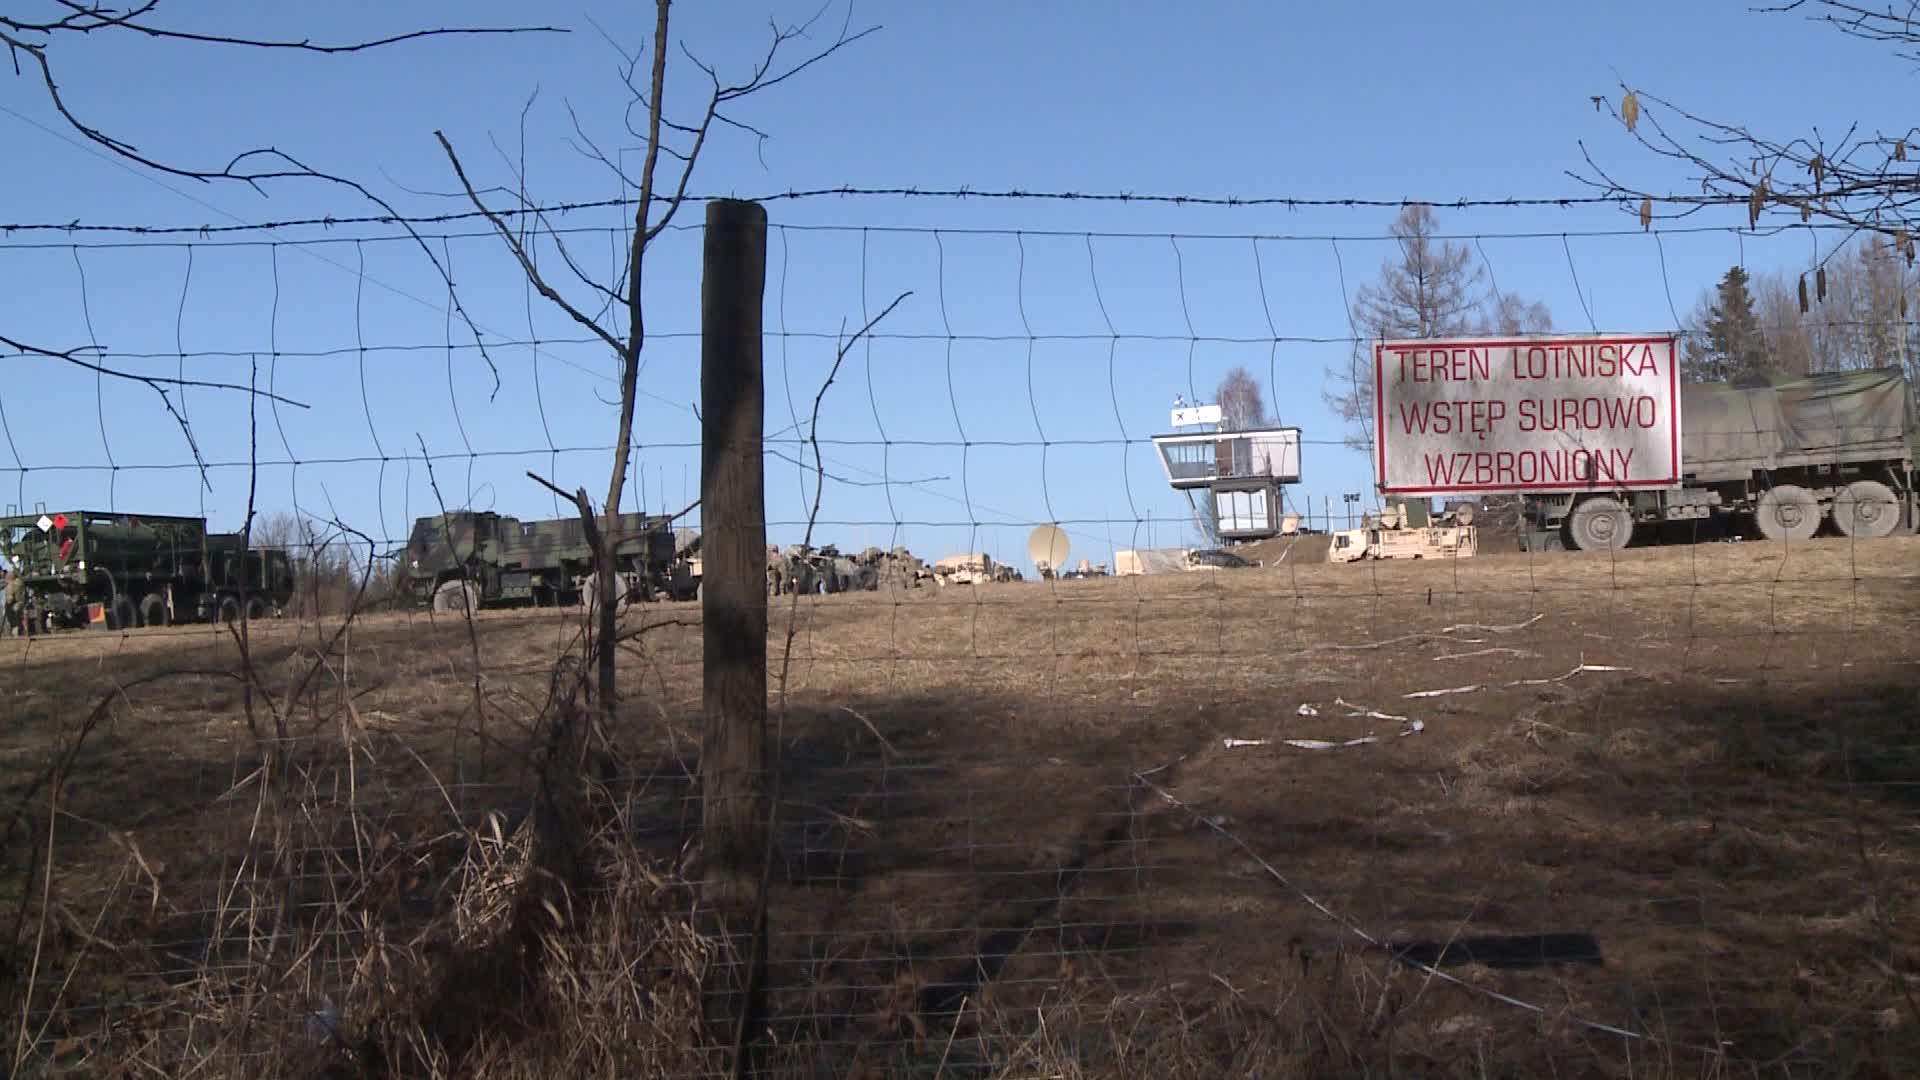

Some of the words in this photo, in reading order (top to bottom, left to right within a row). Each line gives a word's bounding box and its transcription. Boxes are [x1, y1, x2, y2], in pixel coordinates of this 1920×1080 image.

[1395, 349, 1490, 381] TEREN
[1514, 345, 1658, 379] LOTNISKA
[1400, 401, 1506, 440] WSTĘP
[1518, 396, 1656, 431] SUROWO
[1425, 449, 1633, 485] WZBRONIONY
